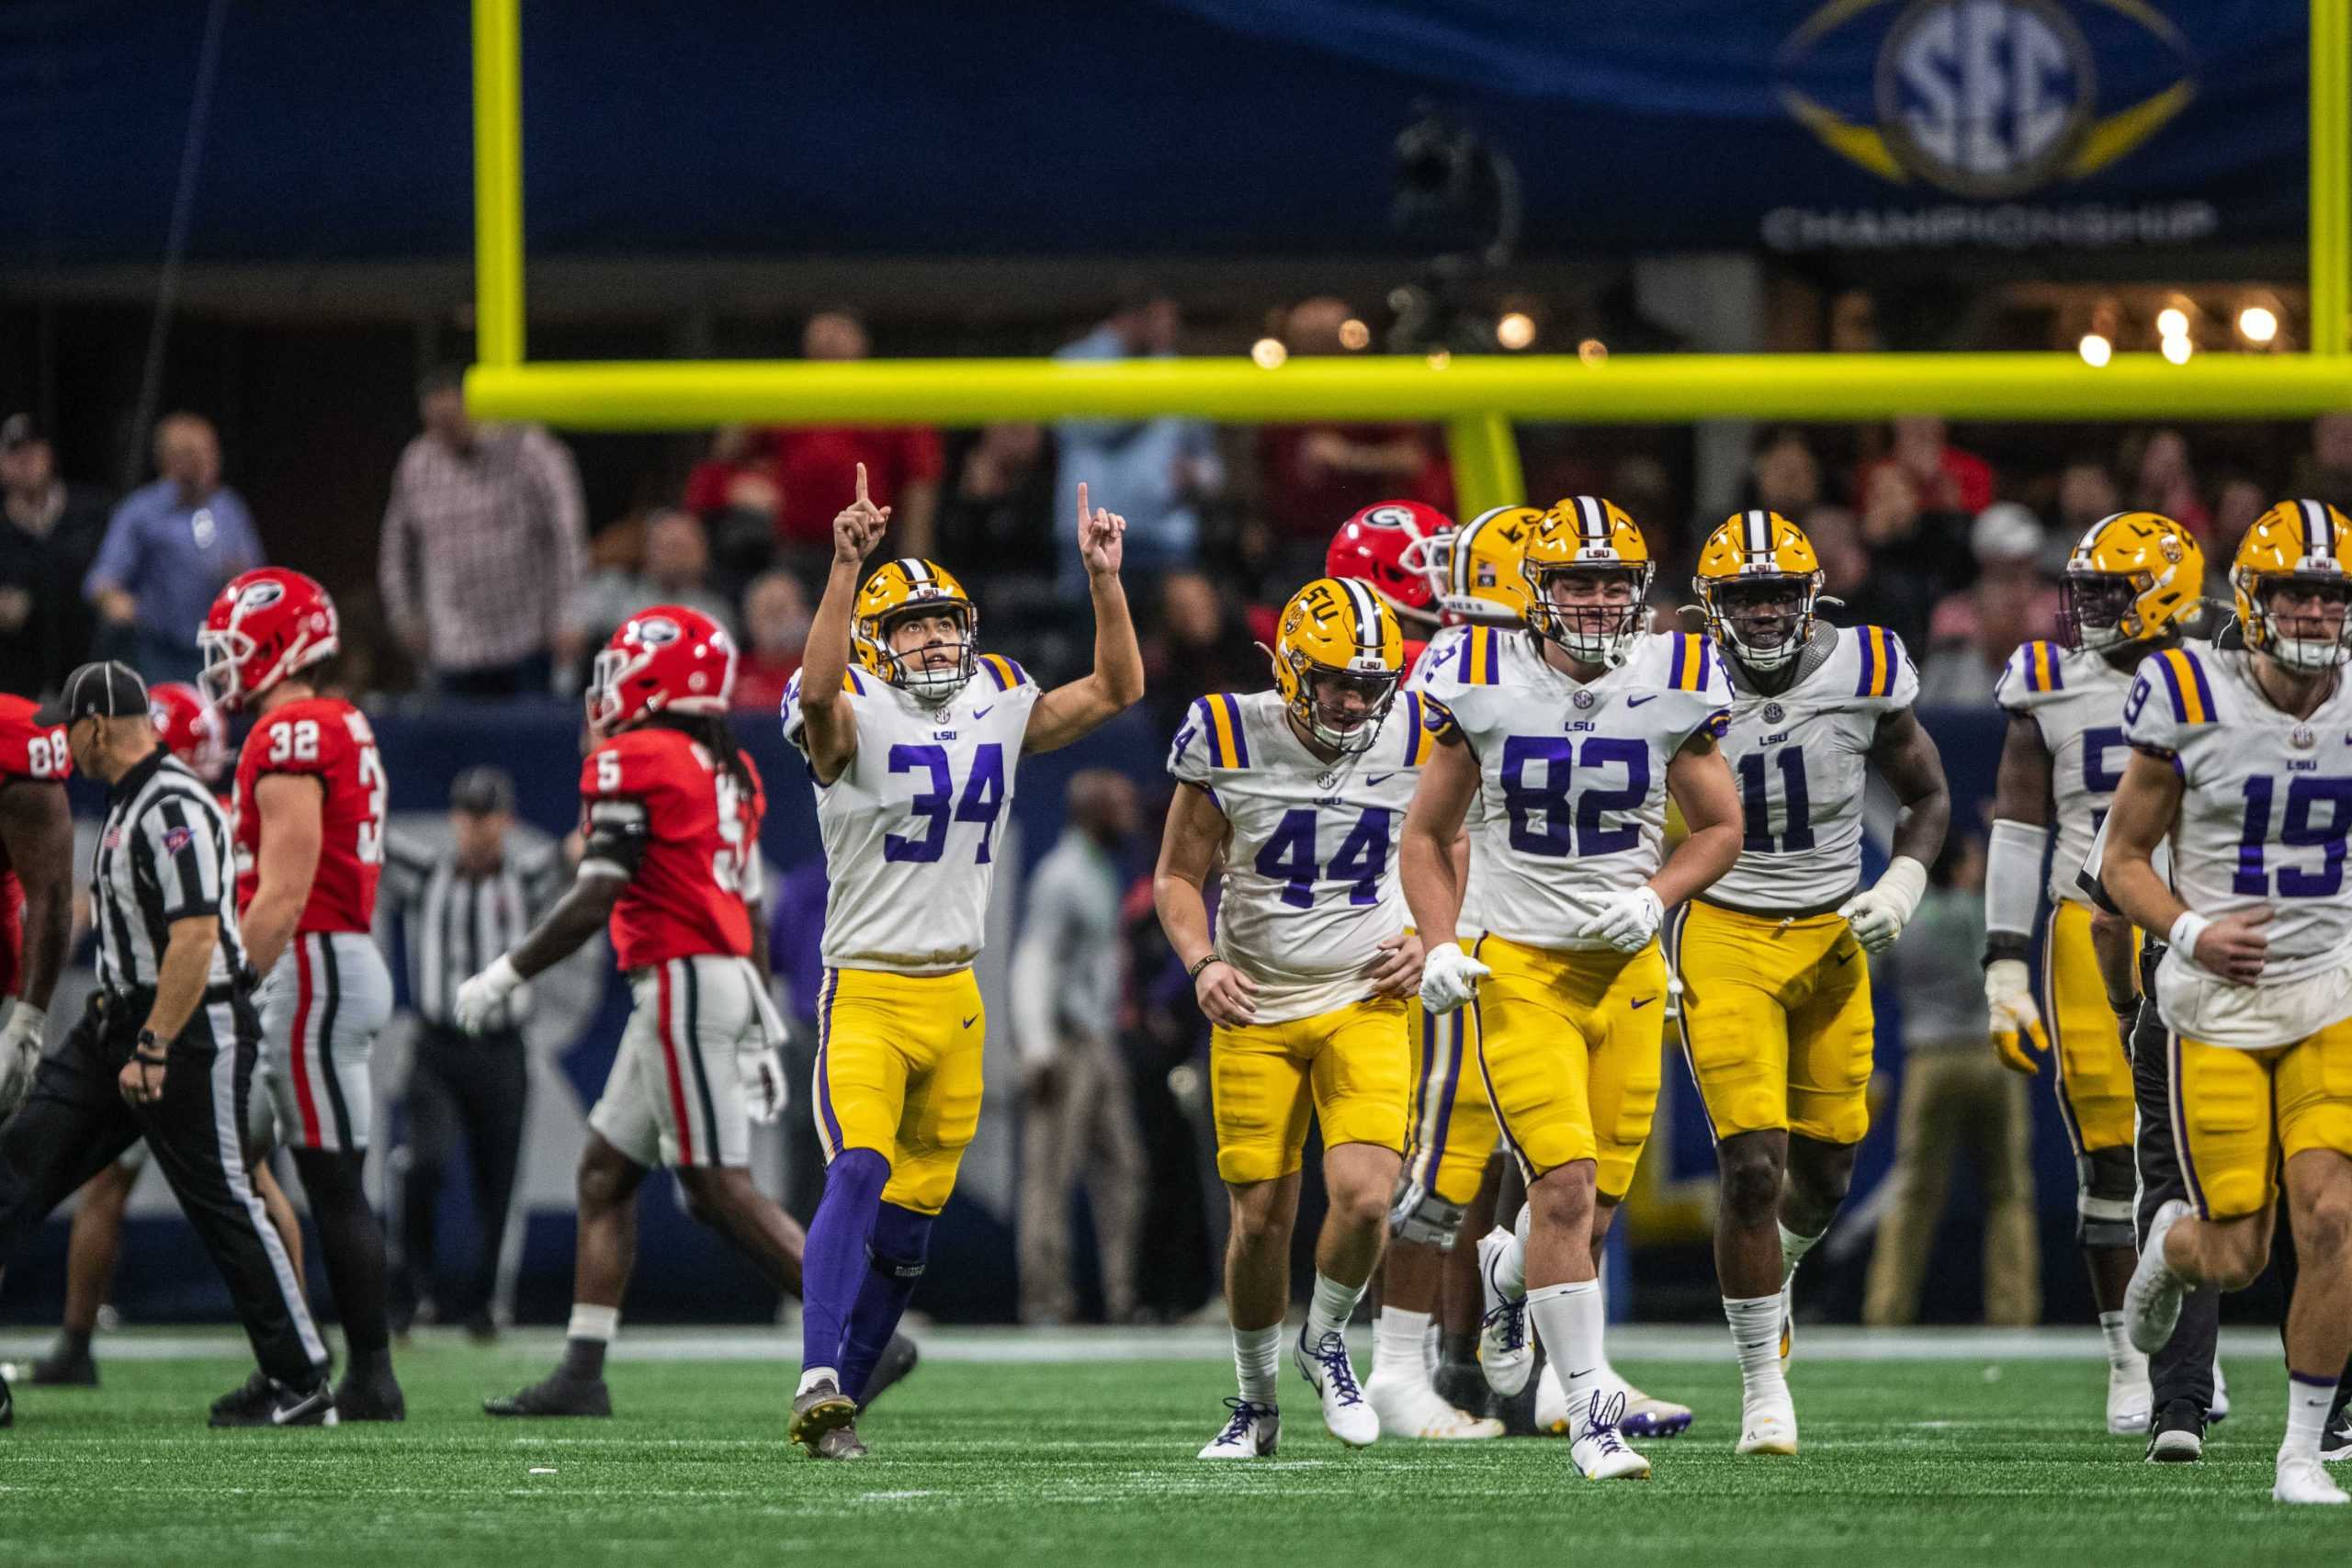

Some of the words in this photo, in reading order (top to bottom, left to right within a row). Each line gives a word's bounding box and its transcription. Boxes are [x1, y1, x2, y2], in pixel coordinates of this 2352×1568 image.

[1896, 0, 2069, 172] SEC
[1760, 201, 2218, 253] CHAMPIONSHIP
[1586, 550, 1610, 558] LSU
[1301, 584, 1339, 623] SU
[1360, 660, 1381, 671] LSU
[269, 719, 320, 762] 32
[933, 731, 957, 740] LSU
[1565, 721, 1595, 732] LSU
[1759, 733, 1788, 746] LSU
[28, 730, 68, 777] 88
[598, 750, 622, 792] 5
[2287, 760, 2317, 770] LSU
[884, 742, 1005, 864] 34
[1500, 735, 1650, 858] 82
[1737, 745, 1815, 853] 11
[2233, 774, 2352, 897] 19
[1254, 807, 1392, 908] 44
